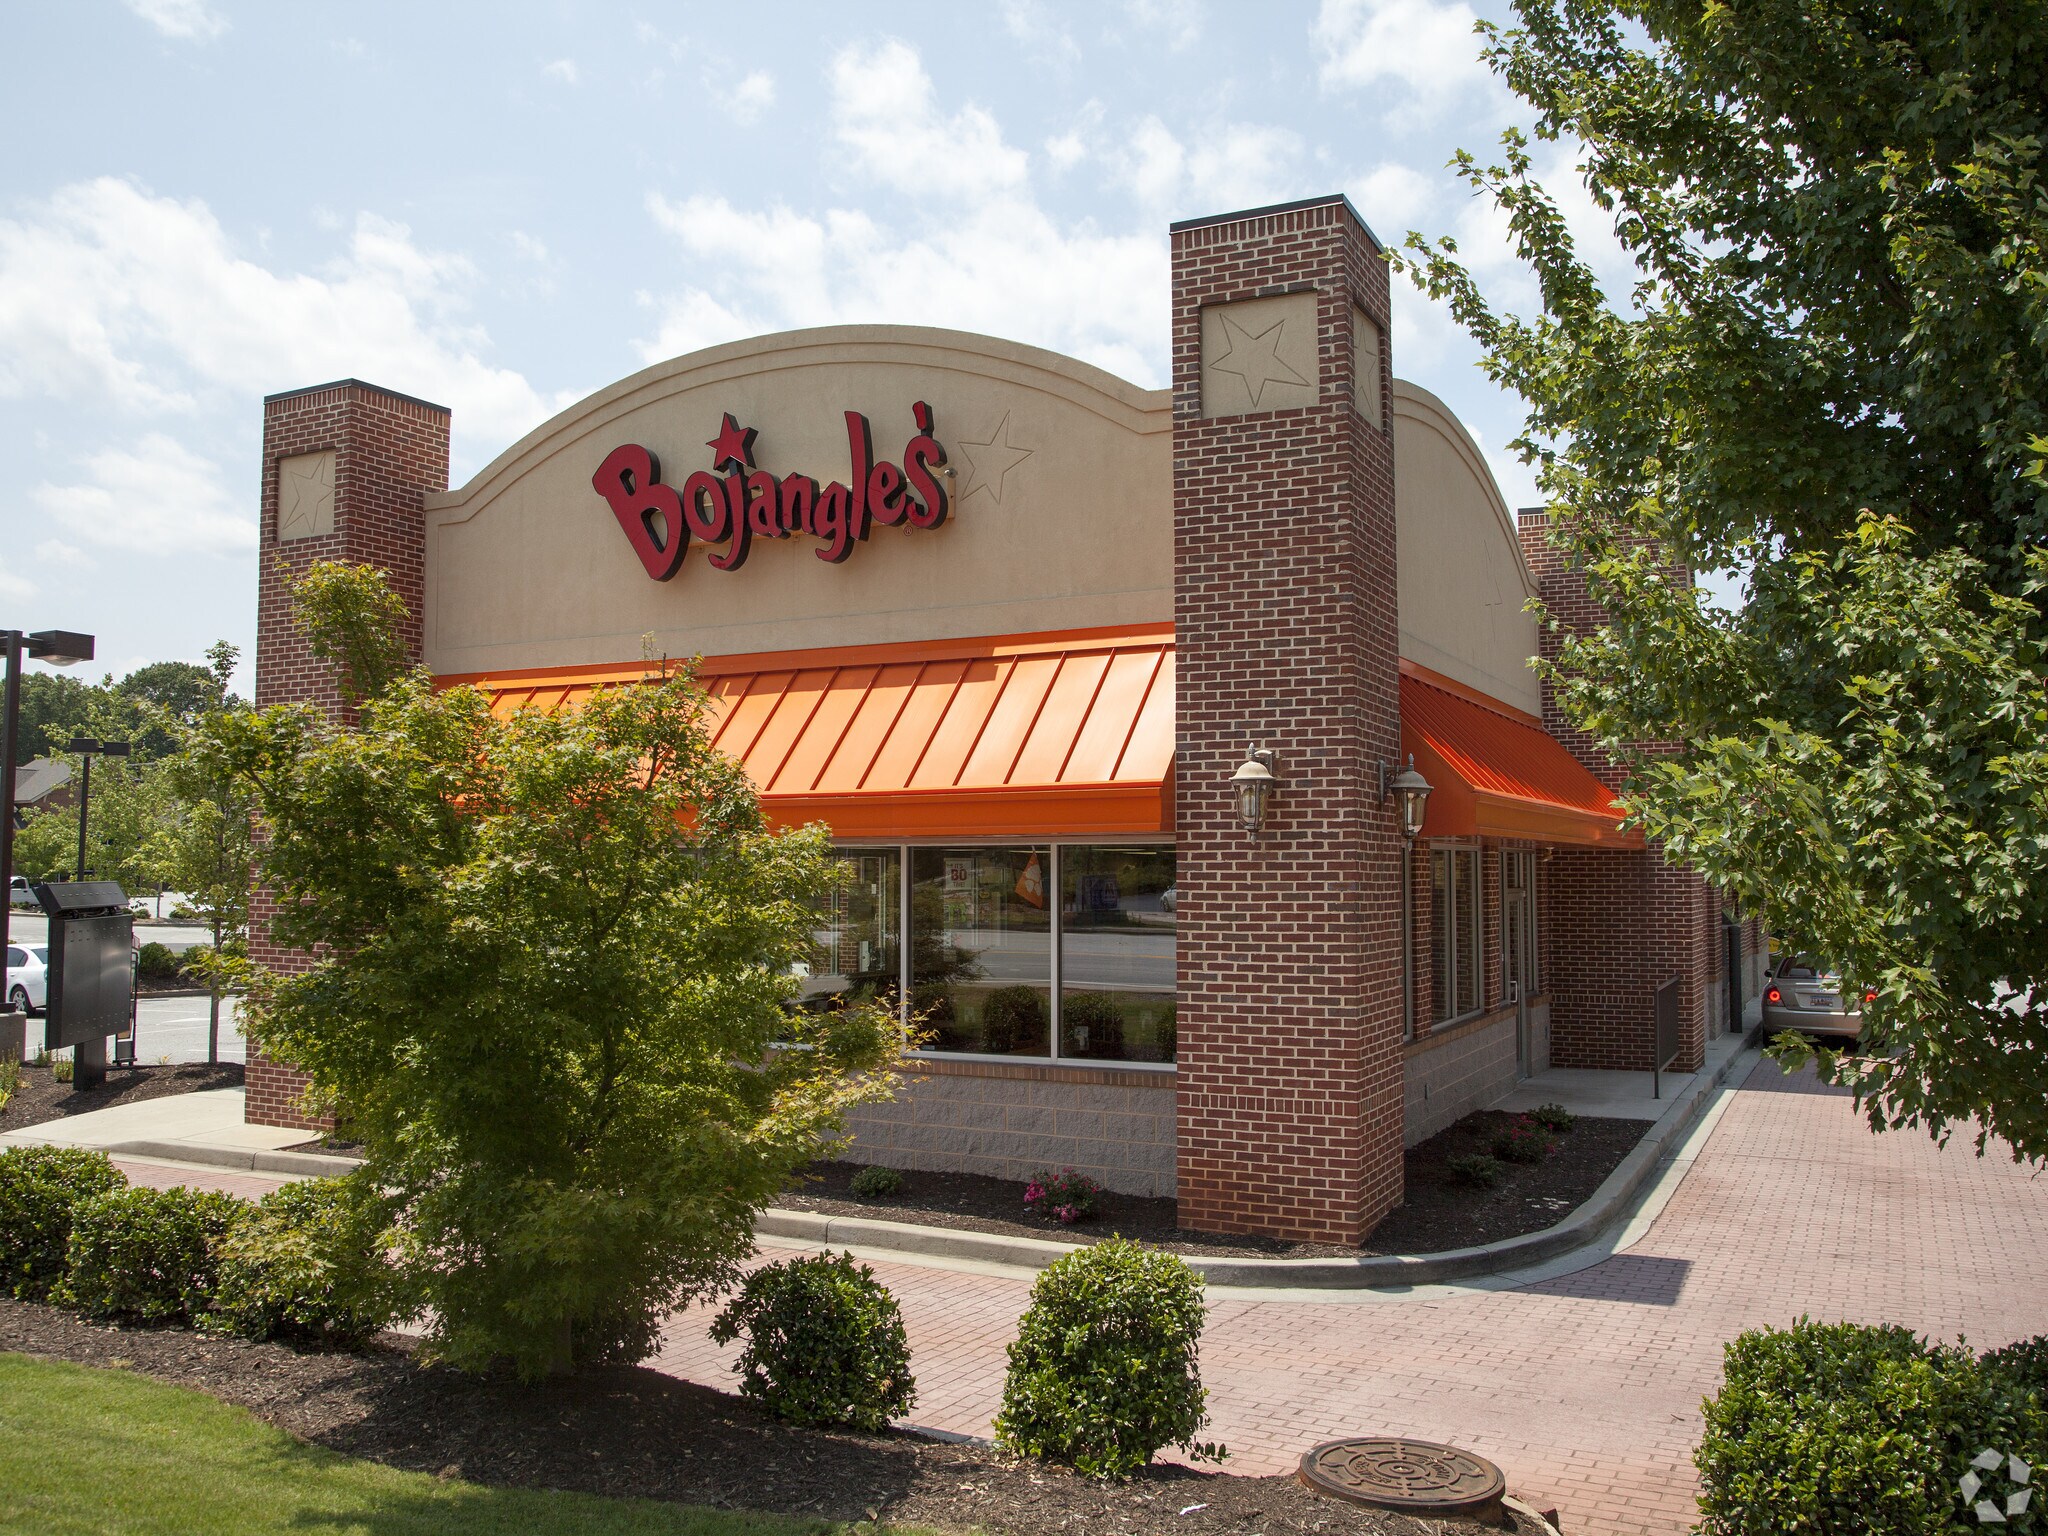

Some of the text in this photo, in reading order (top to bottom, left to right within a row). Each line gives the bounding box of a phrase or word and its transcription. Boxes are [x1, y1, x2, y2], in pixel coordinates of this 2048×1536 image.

[592, 401, 948, 582] Bojangle's
[951, 868, 967, 881] BO
[1354, 1460, 1392, 1484] SEWER
[1416, 1456, 1451, 1480] STORM
